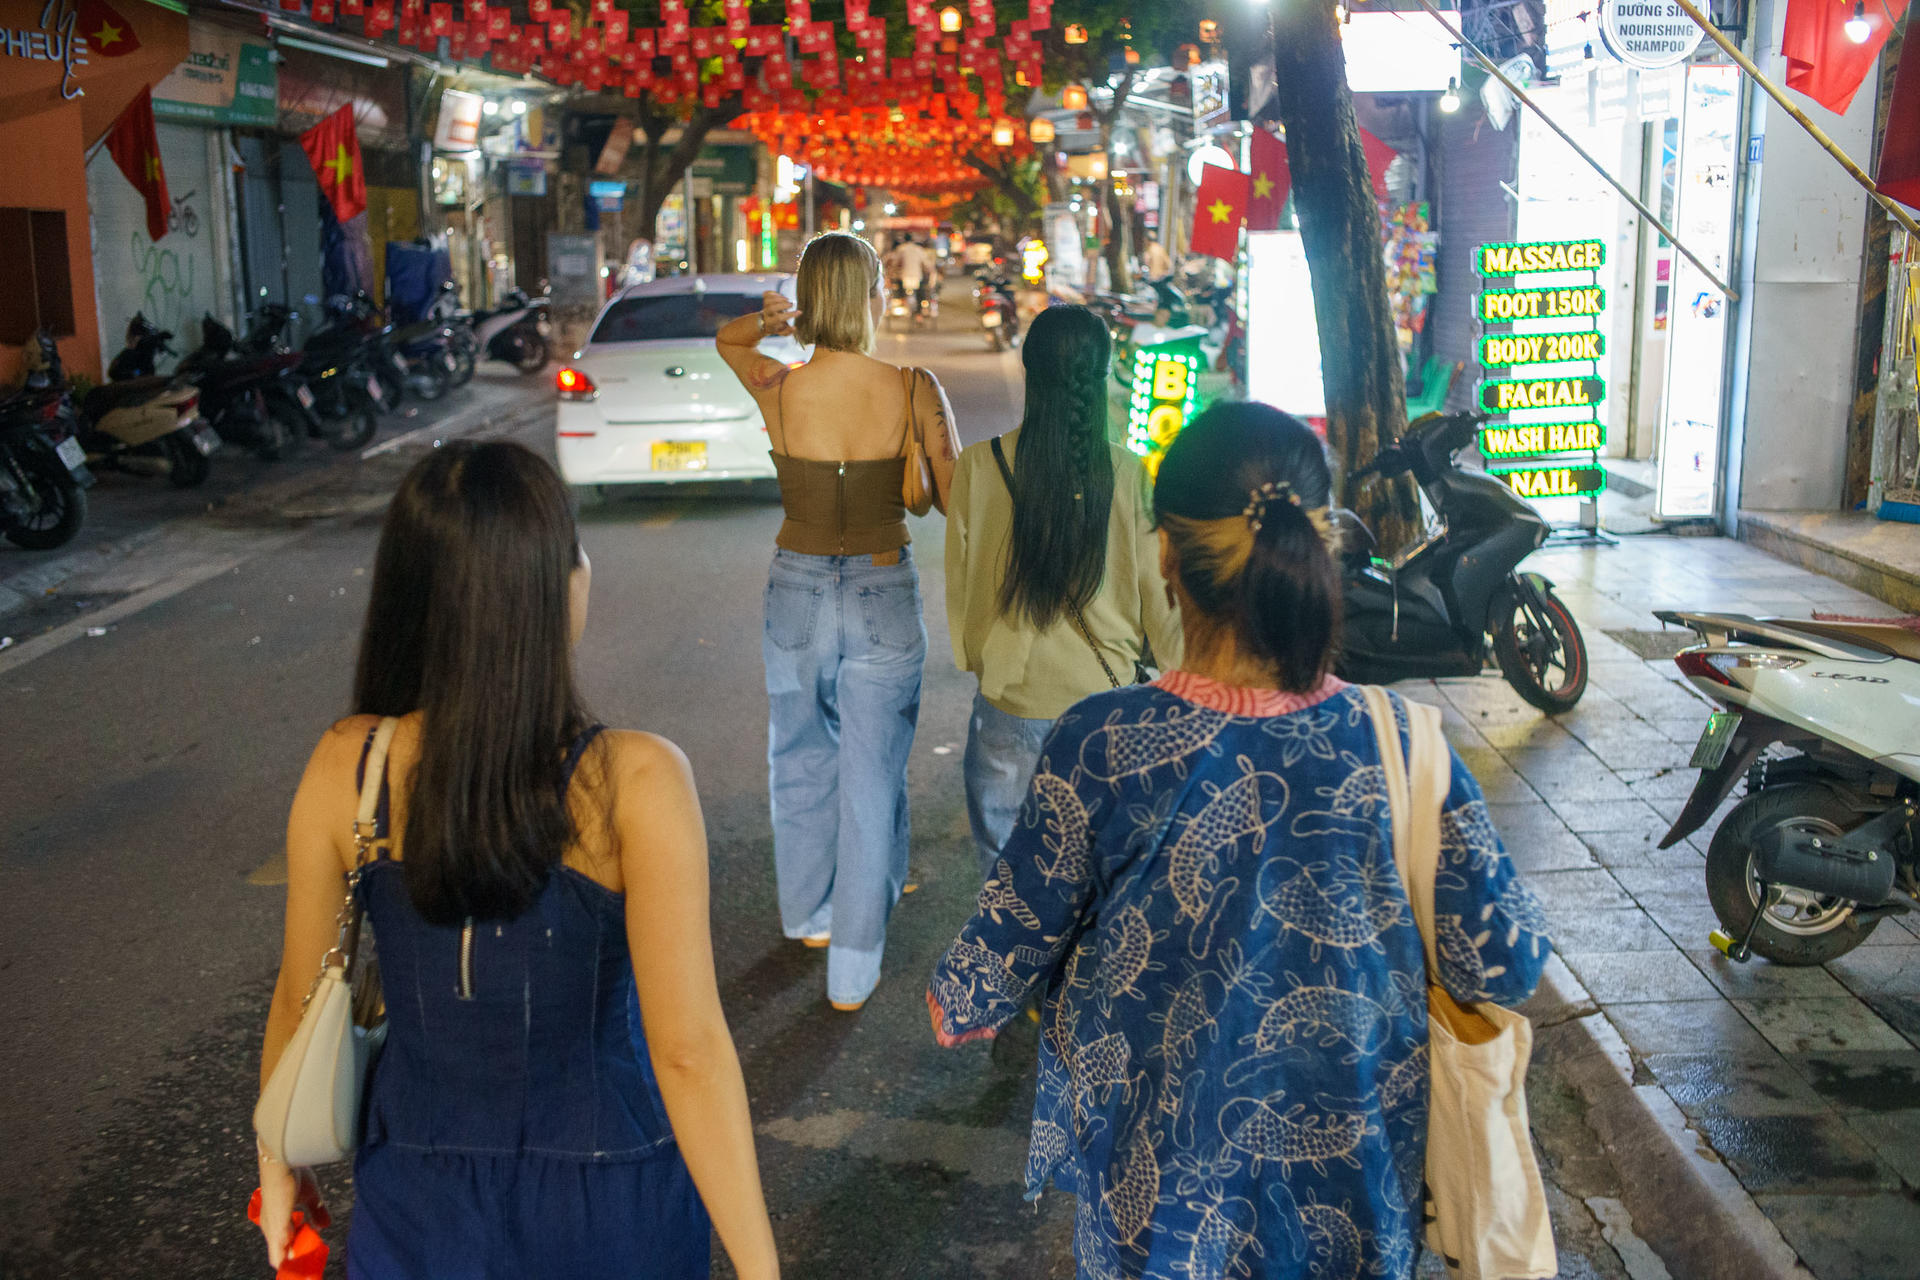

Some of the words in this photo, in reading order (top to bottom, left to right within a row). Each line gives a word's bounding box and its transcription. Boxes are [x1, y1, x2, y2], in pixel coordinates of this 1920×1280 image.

[1619, 24, 1694, 37] NOURISHING
[1626, 40, 1685, 52] SHAMPOO
[1485, 243, 1600, 272] MASSAGE
[1485, 291, 1542, 319] FOOT
[1546, 288, 1600, 316] 150K
[1487, 336, 1544, 364] BODY
[1545, 333, 1600, 361] 200K
[1498, 380, 1589, 409] FACIAL
[1485, 427, 1546, 454] WASH
[1548, 423, 1599, 452] HAIR
[1510, 468, 1578, 496] NAIL
[1811, 671, 1890, 684] LEAD
